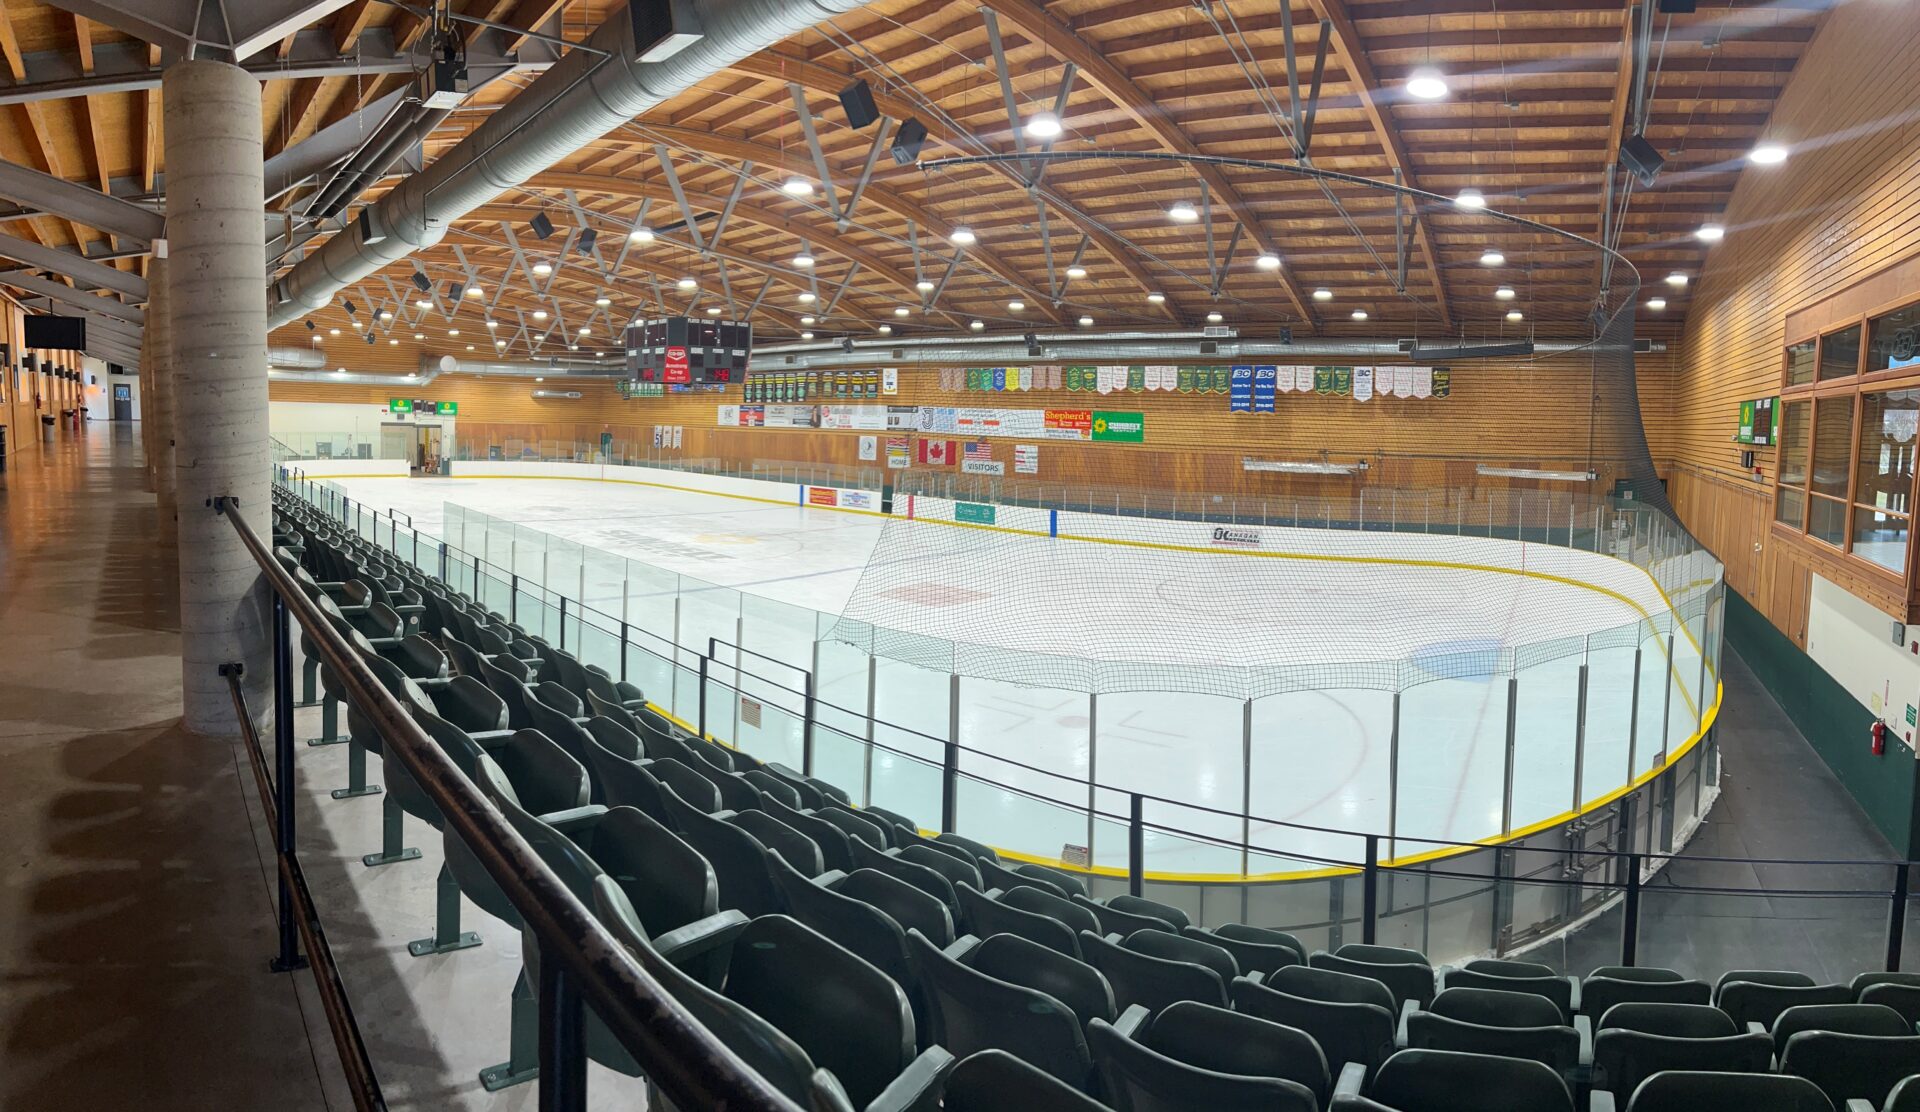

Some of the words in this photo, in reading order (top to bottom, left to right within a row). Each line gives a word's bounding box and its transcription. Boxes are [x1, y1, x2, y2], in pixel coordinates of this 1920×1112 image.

[1045, 411, 1091, 421] Shepherd's
[890, 458, 907, 466] HOME
[967, 463, 999, 472] VISITORS
